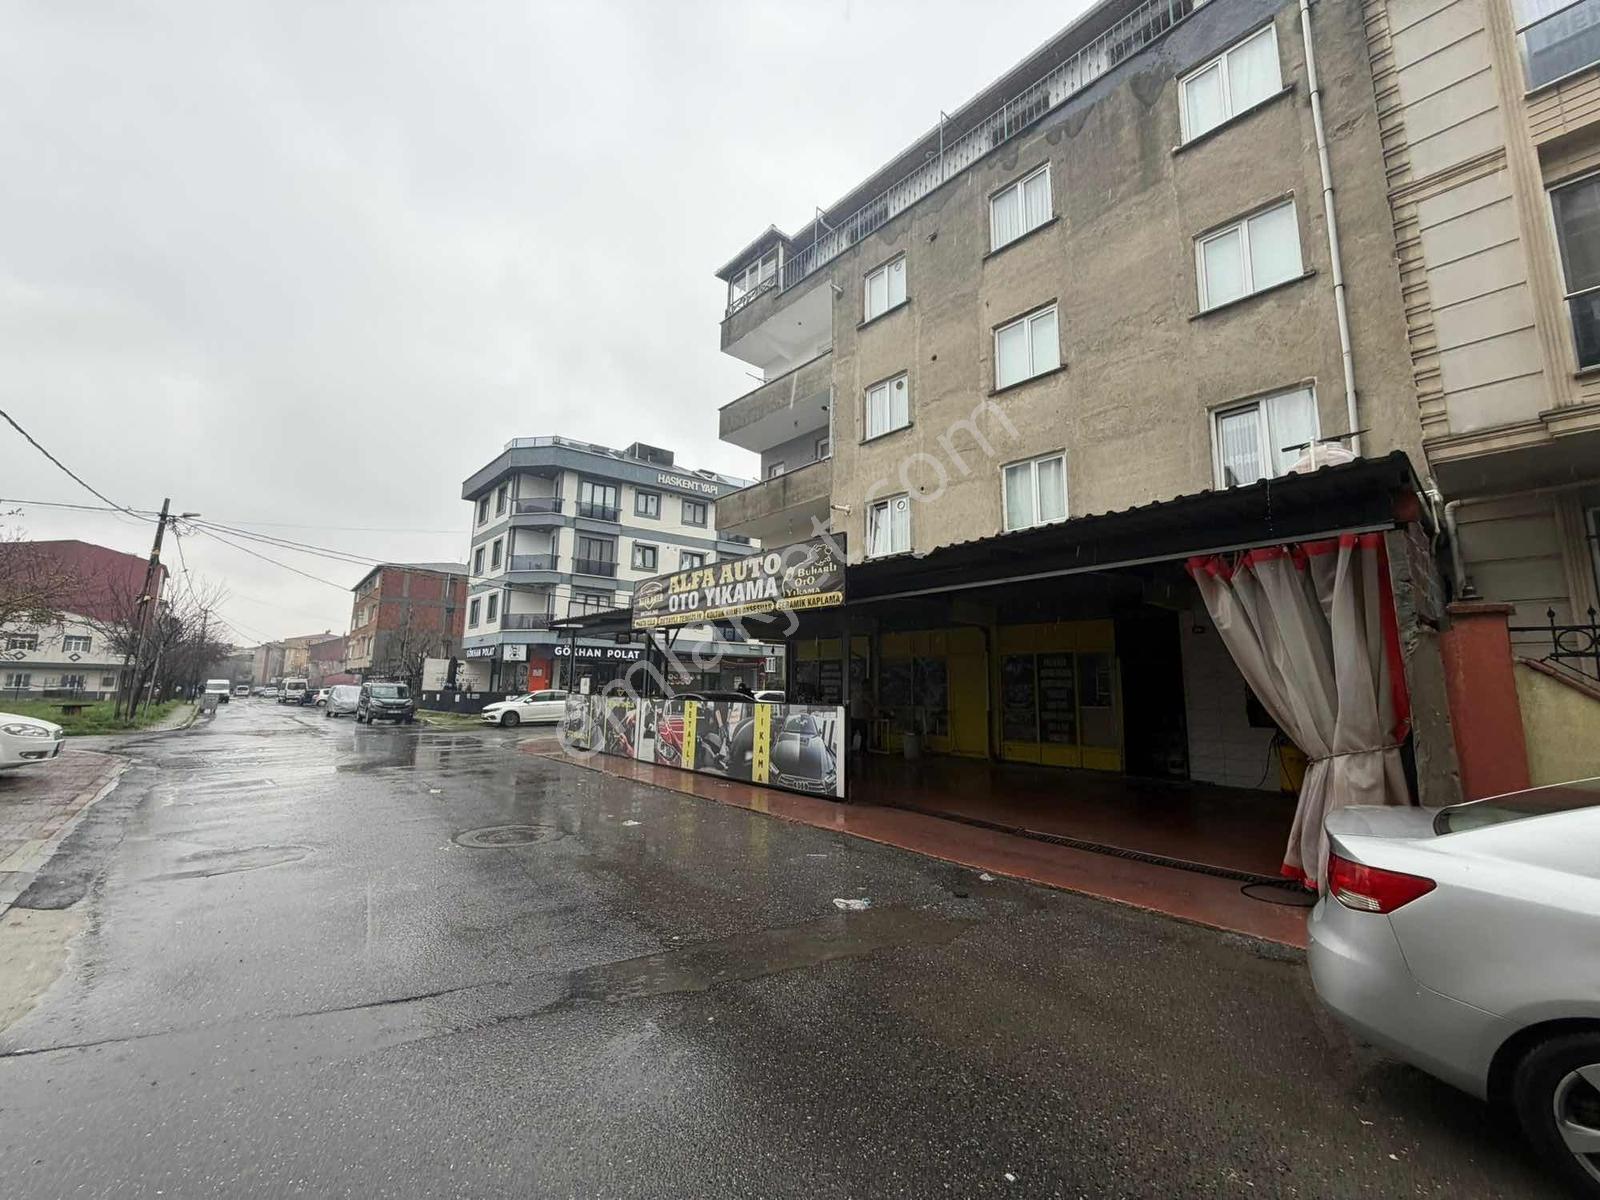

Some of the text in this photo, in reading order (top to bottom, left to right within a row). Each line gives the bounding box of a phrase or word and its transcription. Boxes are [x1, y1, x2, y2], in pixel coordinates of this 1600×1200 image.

[658, 473, 719, 495] HASKENT YAPI
[668, 553, 782, 595] ALFA AUTO
[668, 590, 700, 613] OTO
[704, 576, 778, 607] YIKAMA
[607, 649, 640, 659] POLAT
